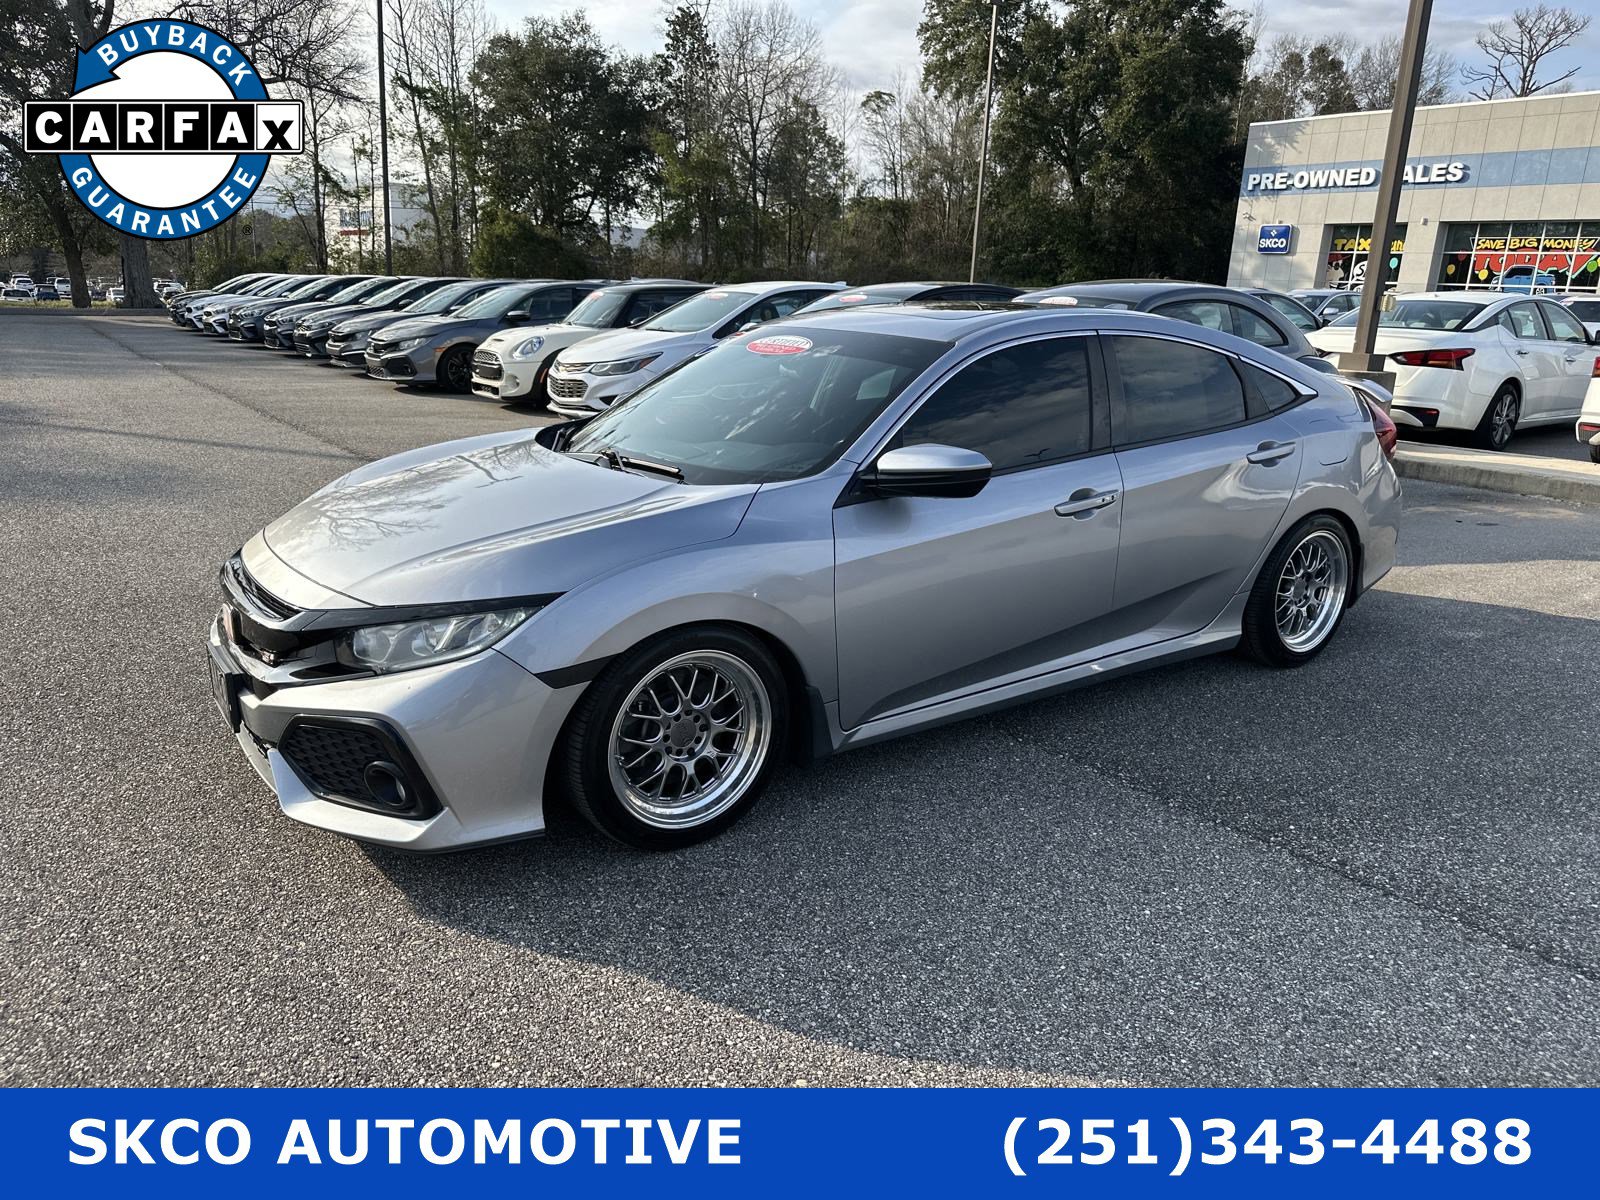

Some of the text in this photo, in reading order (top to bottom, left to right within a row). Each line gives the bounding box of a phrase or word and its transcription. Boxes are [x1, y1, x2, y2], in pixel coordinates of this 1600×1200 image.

[1247, 162, 1465, 190] PRE-OWNED ALES
[1259, 238, 1287, 248] SKCO
[1334, 238, 1371, 251] TAX
[1477, 238, 1595, 249] SAVE BIG MONEY
[1473, 247, 1598, 279] TODAY
